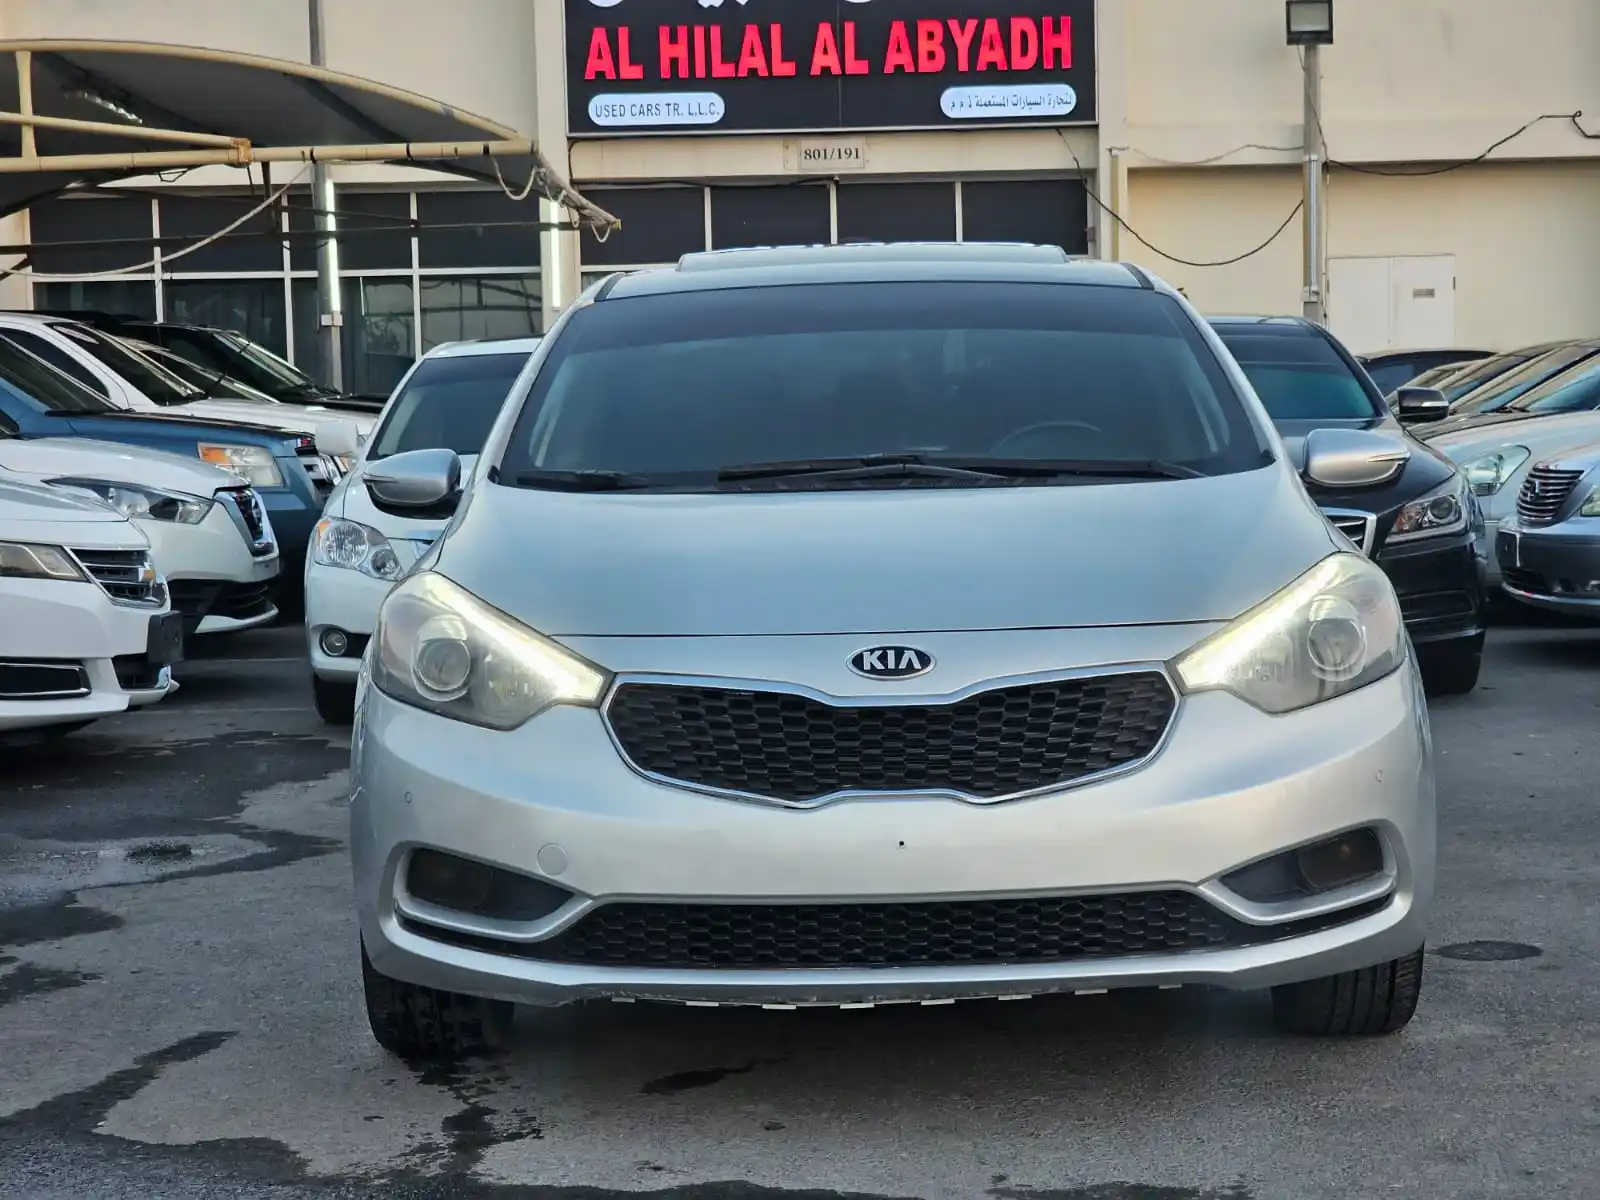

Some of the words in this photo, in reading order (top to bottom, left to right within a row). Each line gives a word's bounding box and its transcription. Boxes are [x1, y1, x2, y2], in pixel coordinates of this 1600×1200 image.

[584, 26, 644, 80] AL
[658, 22, 796, 79] HILAL
[809, 21, 870, 76] AL
[883, 15, 1073, 74] ABYADH
[975, 95, 1009, 108] المستعملة
[1011, 94, 1046, 110] السيارات
[595, 104, 626, 118] USED
[630, 103, 661, 117] CARS
[665, 102, 684, 116] TR.
[687, 102, 720, 116] L.L.C.
[803, 147, 859, 161] 801/191
[862, 649, 922, 671] KIA
